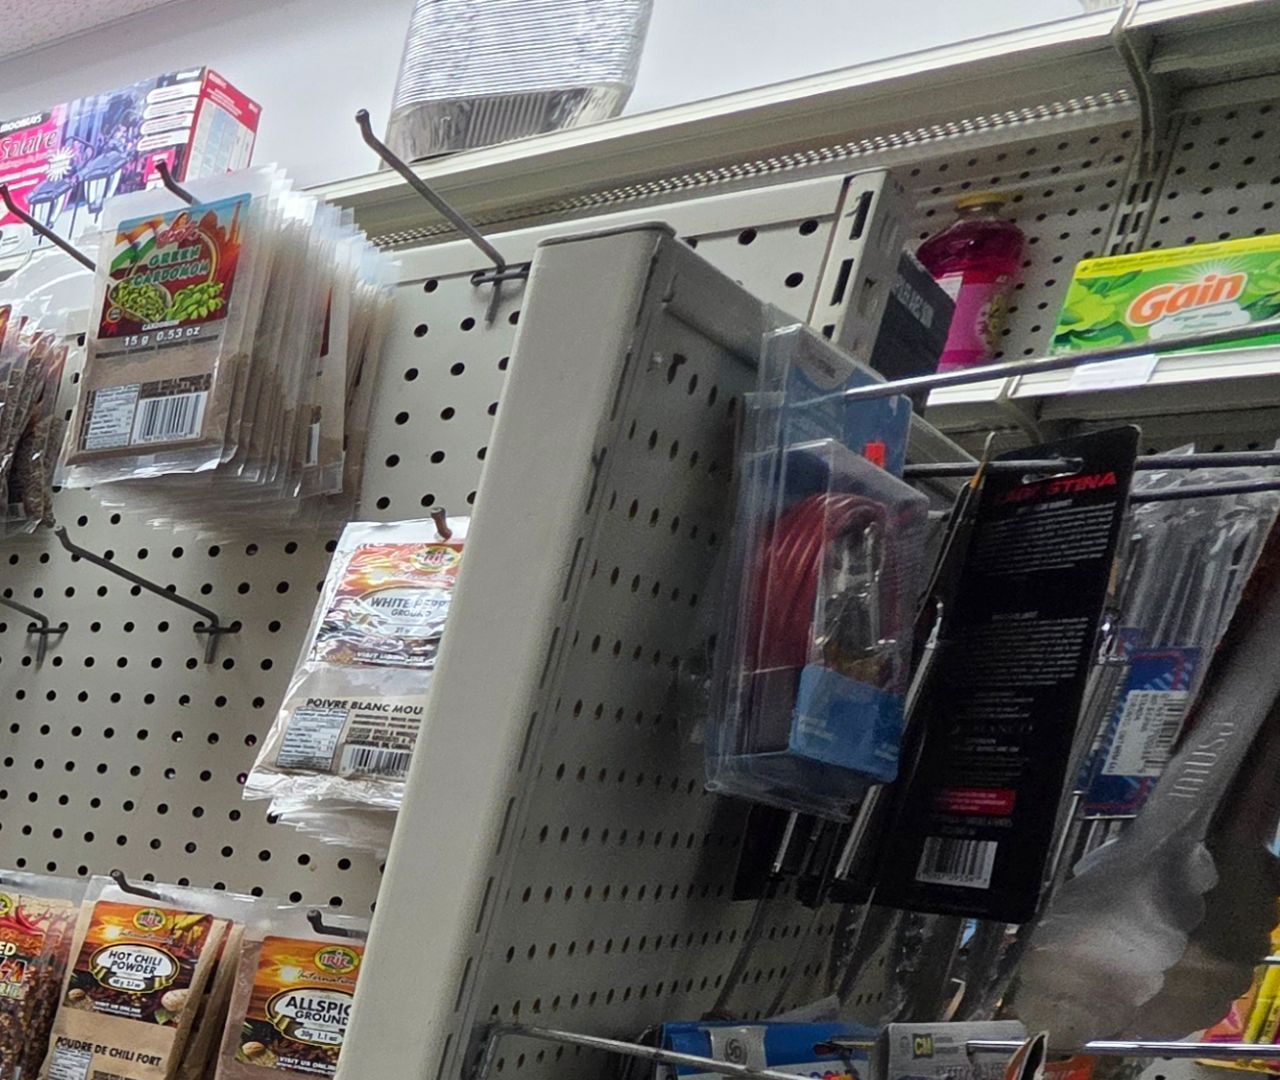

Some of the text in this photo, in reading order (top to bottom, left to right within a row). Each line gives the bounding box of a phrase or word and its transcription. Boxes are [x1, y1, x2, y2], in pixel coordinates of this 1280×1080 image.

[148, 247, 200, 268] GREEN
[1129, 273, 1246, 325] Gain
[125, 335, 139, 346] 15
[141, 335, 149, 346] g
[156, 328, 183, 342] 0.53
[371, 597, 408, 610] WHITE
[306, 697, 423, 716] POIVRE BLANC MOU
[108, 950, 163, 968] HOT CHILI
[110, 960, 157, 975] POWDER
[286, 996, 353, 1016] ALLSPIC
[56, 1036, 162, 1065] POUDRE DE CHILI FORT
